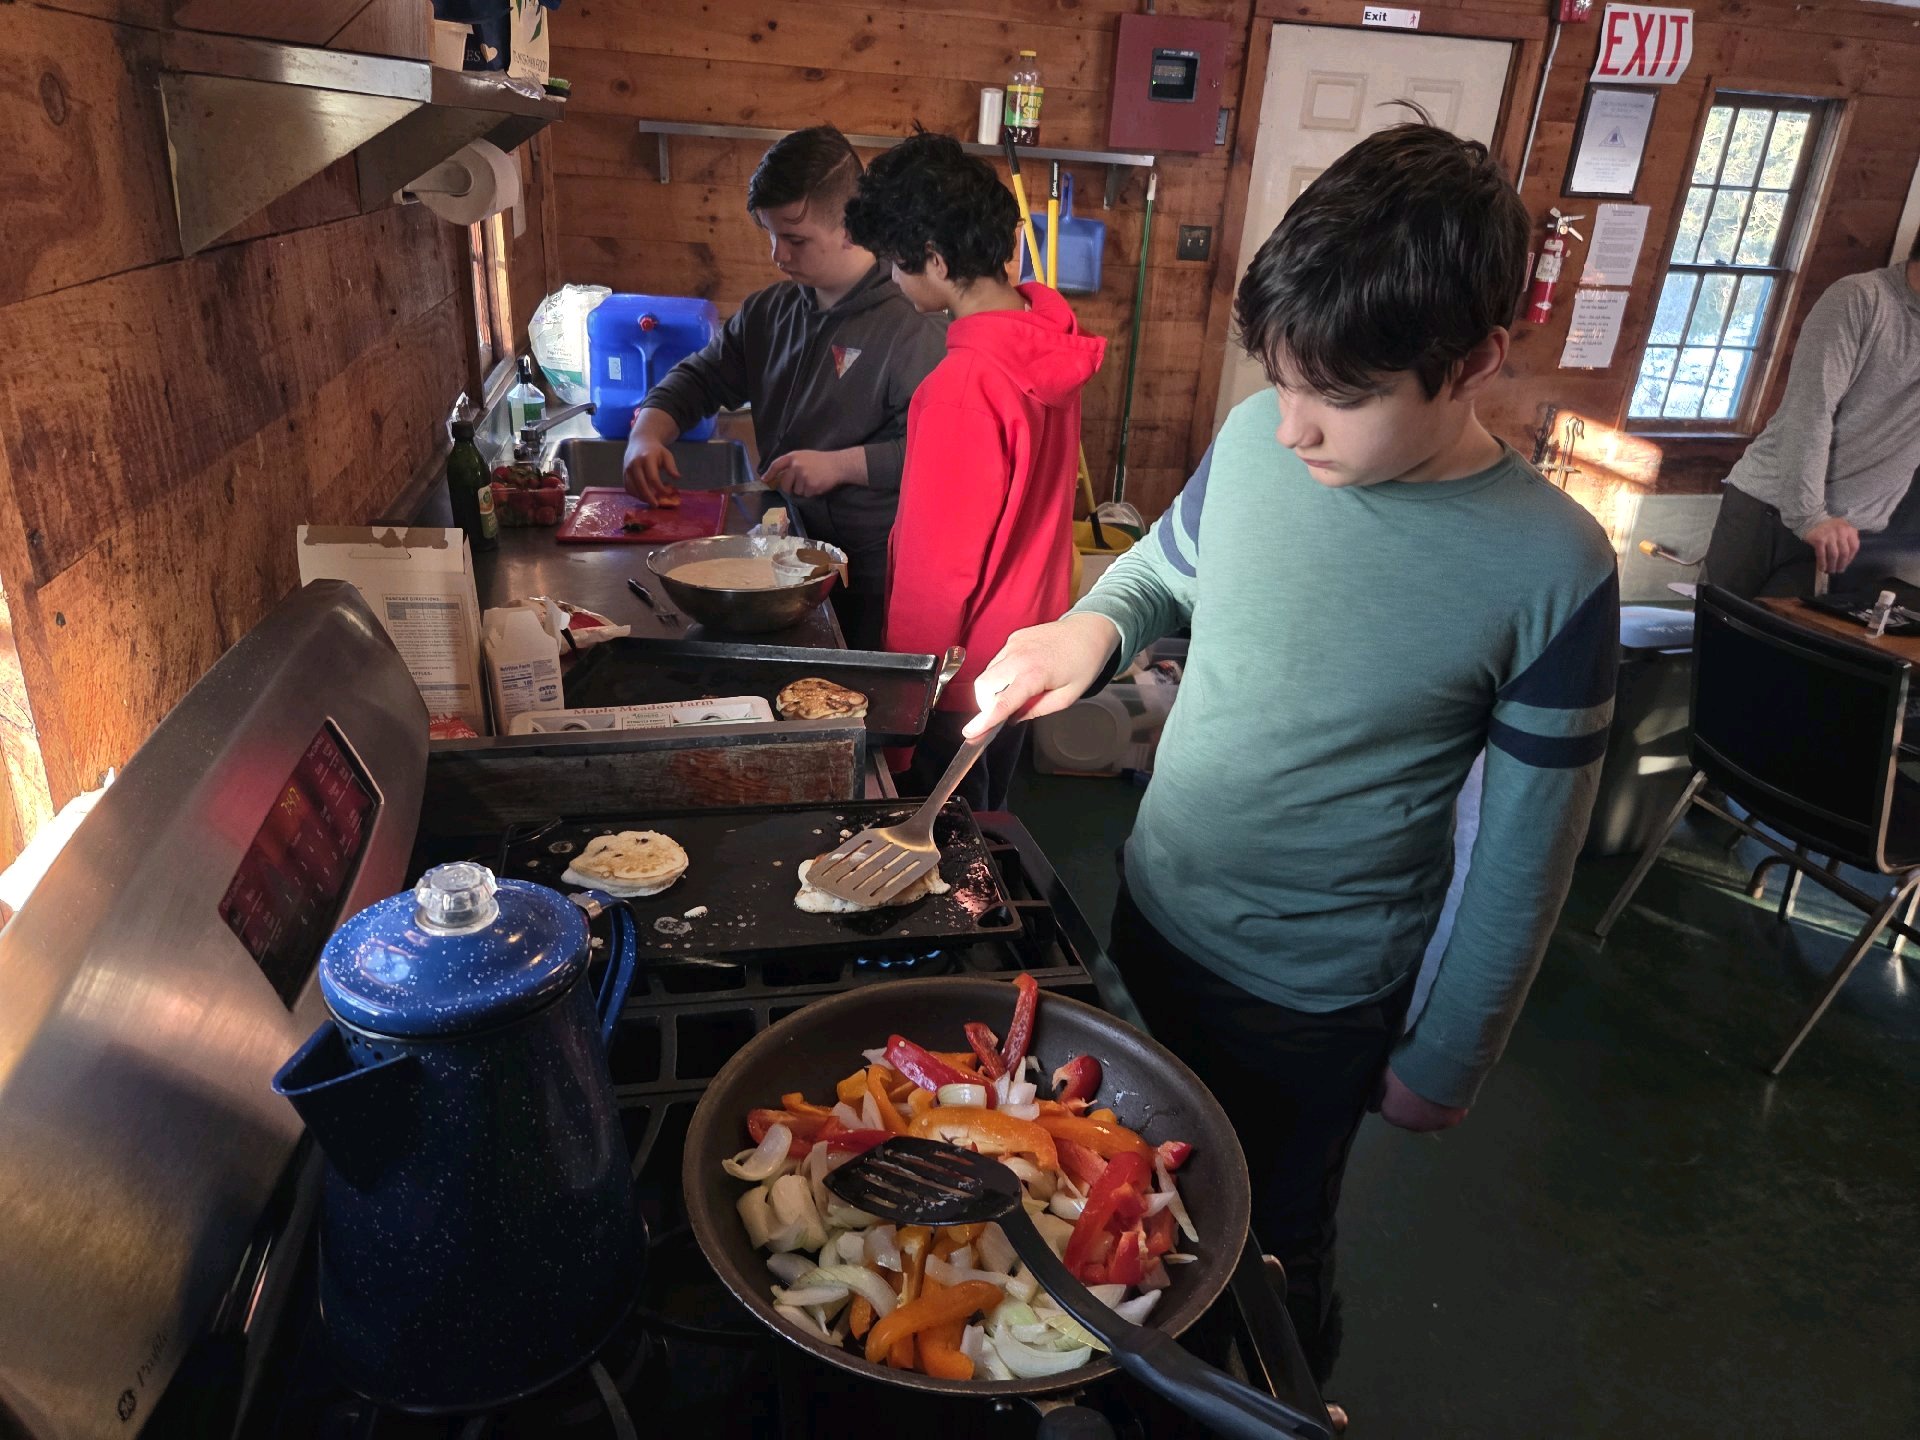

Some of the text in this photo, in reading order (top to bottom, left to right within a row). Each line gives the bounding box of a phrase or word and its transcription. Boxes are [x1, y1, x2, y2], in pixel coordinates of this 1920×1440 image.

[1364, 11, 1387, 21] Exit
[1598, 11, 1689, 77] EXIT
[619, 703, 675, 712] Meadow
[680, 699, 714, 708] Farm
[280, 786, 301, 816] 7:47
